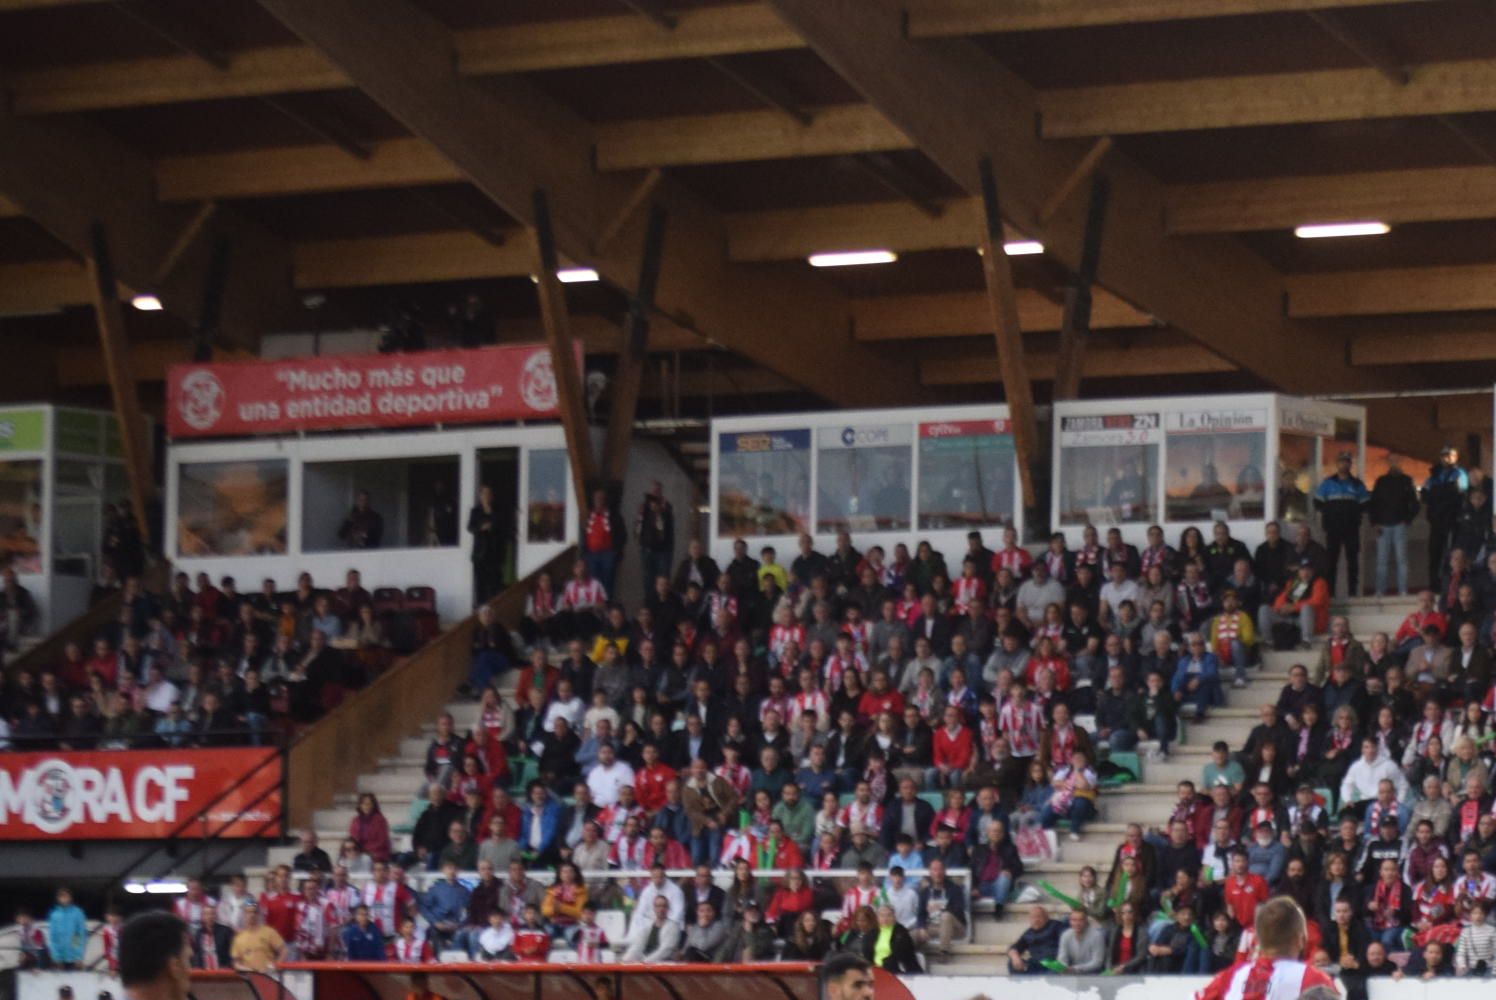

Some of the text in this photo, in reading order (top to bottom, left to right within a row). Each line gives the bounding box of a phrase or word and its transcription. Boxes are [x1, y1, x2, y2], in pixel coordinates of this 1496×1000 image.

[367, 364, 415, 388] más
[421, 363, 465, 388] que
[238, 401, 280, 422] una
[286, 391, 372, 419] entidad
